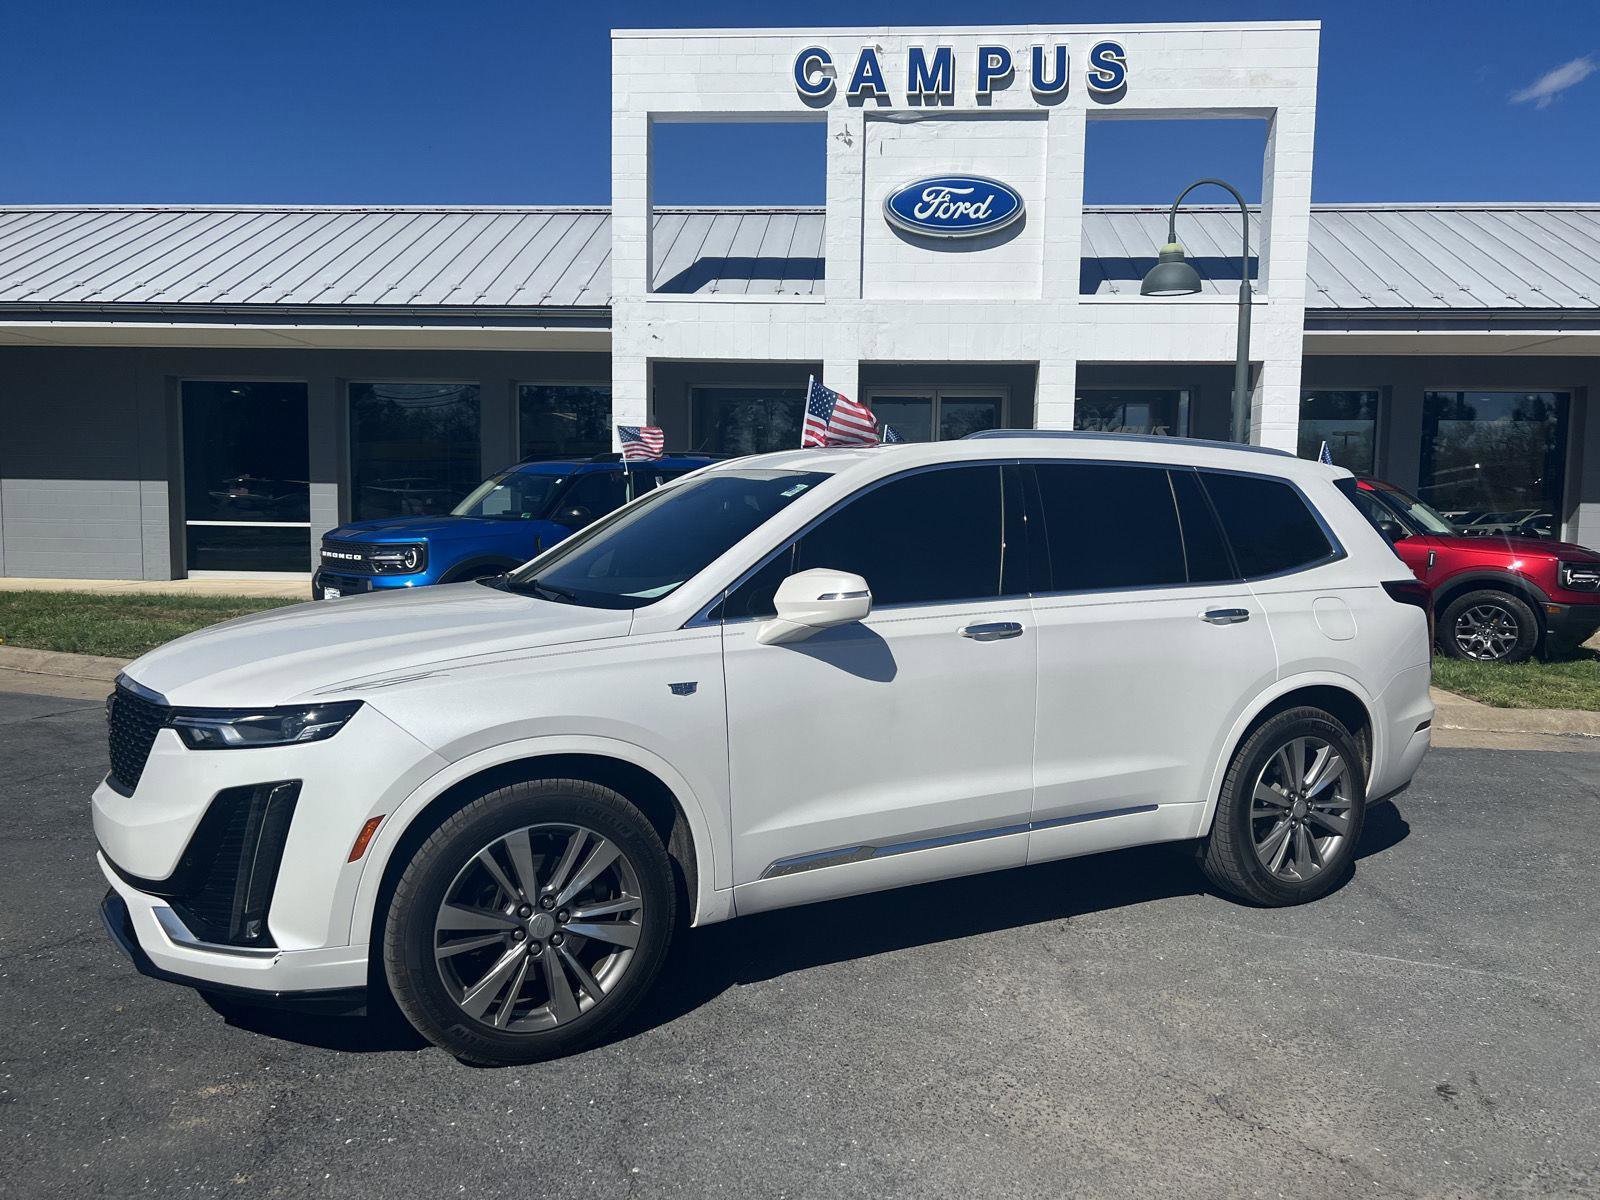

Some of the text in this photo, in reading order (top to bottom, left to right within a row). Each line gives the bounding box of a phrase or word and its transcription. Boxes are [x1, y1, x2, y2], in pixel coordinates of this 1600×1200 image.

[793, 41, 1129, 97] CAMPUS
[913, 186, 995, 220] Ford
[322, 550, 362, 561] BRONCO
